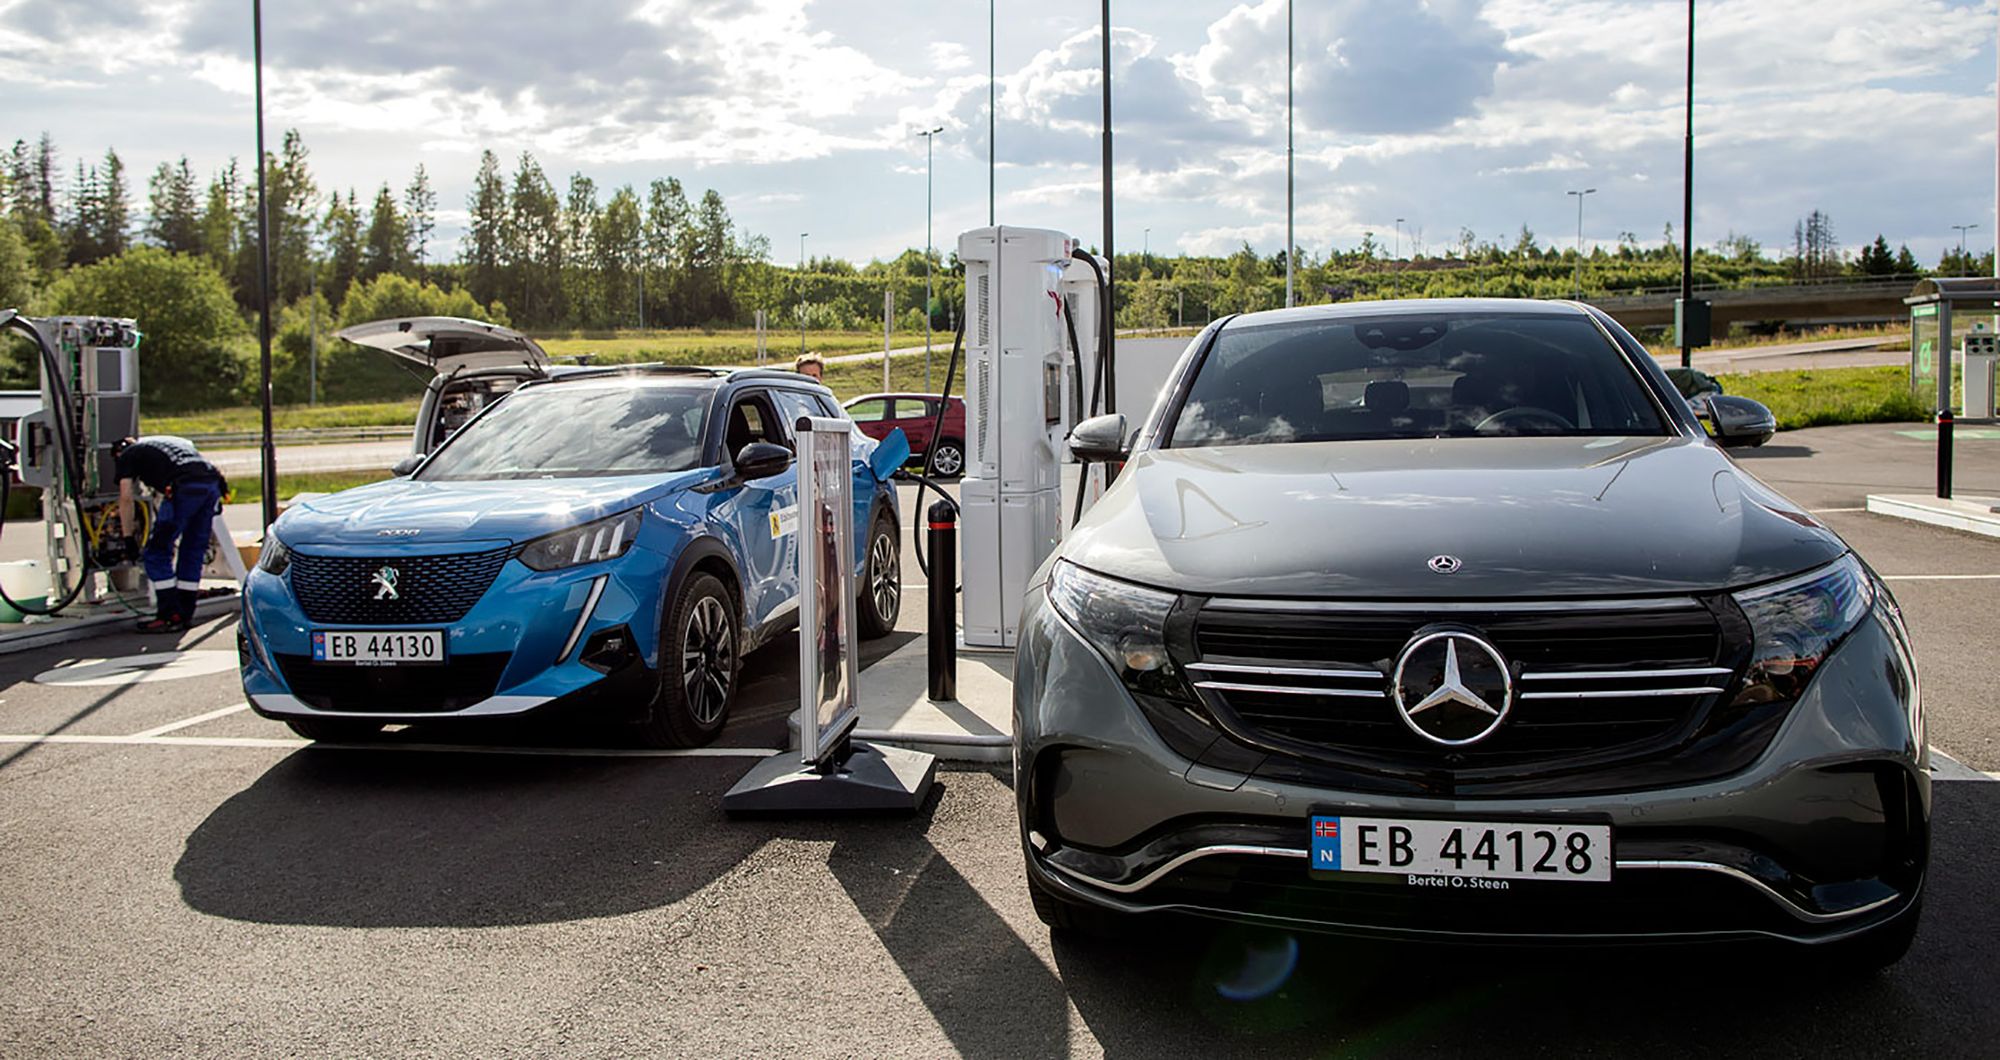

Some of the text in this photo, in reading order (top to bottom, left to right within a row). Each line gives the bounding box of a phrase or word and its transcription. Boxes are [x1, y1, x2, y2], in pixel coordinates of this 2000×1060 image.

[332, 635, 434, 657] EB 44130
[1320, 849, 1333, 862] N
[1357, 825, 1593, 875] EB 44128
[1407, 874, 1510, 890] Bertel O. Steen
